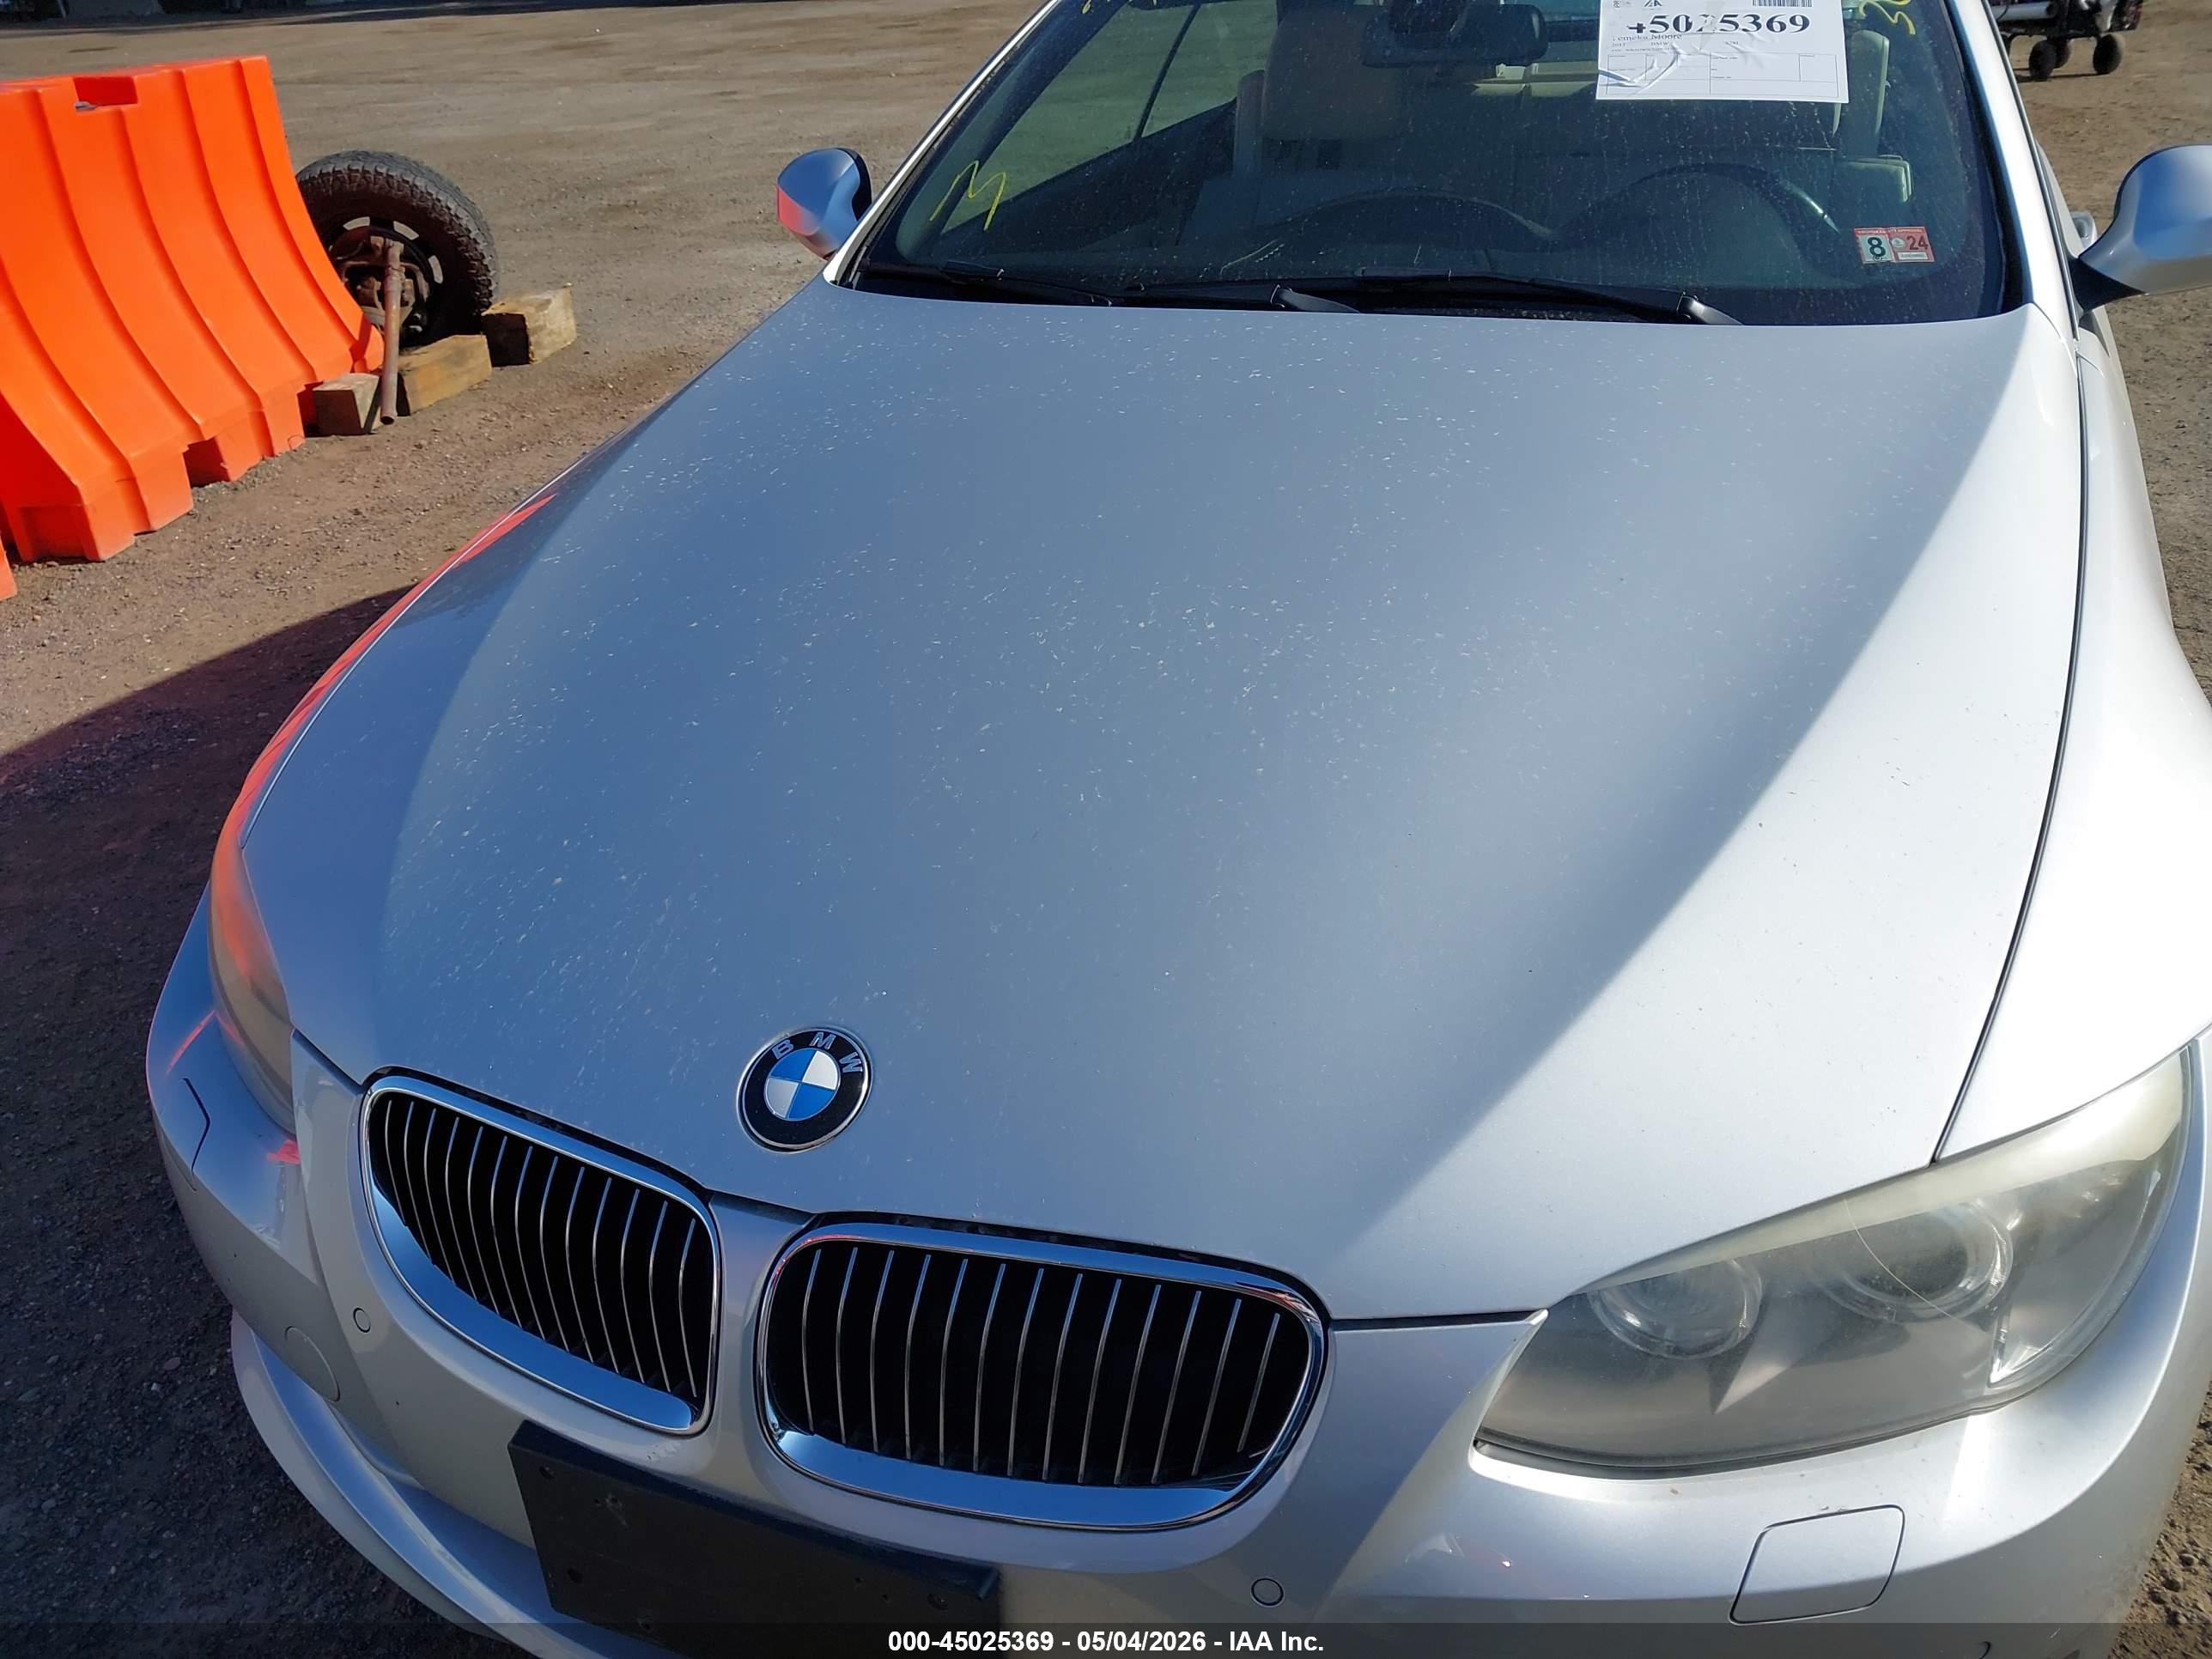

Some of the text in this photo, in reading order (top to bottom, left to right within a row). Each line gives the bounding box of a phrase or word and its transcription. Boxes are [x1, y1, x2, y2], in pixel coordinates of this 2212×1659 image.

[1867, 234, 1929, 258] 8 24
[771, 1031, 864, 1073] BMW
